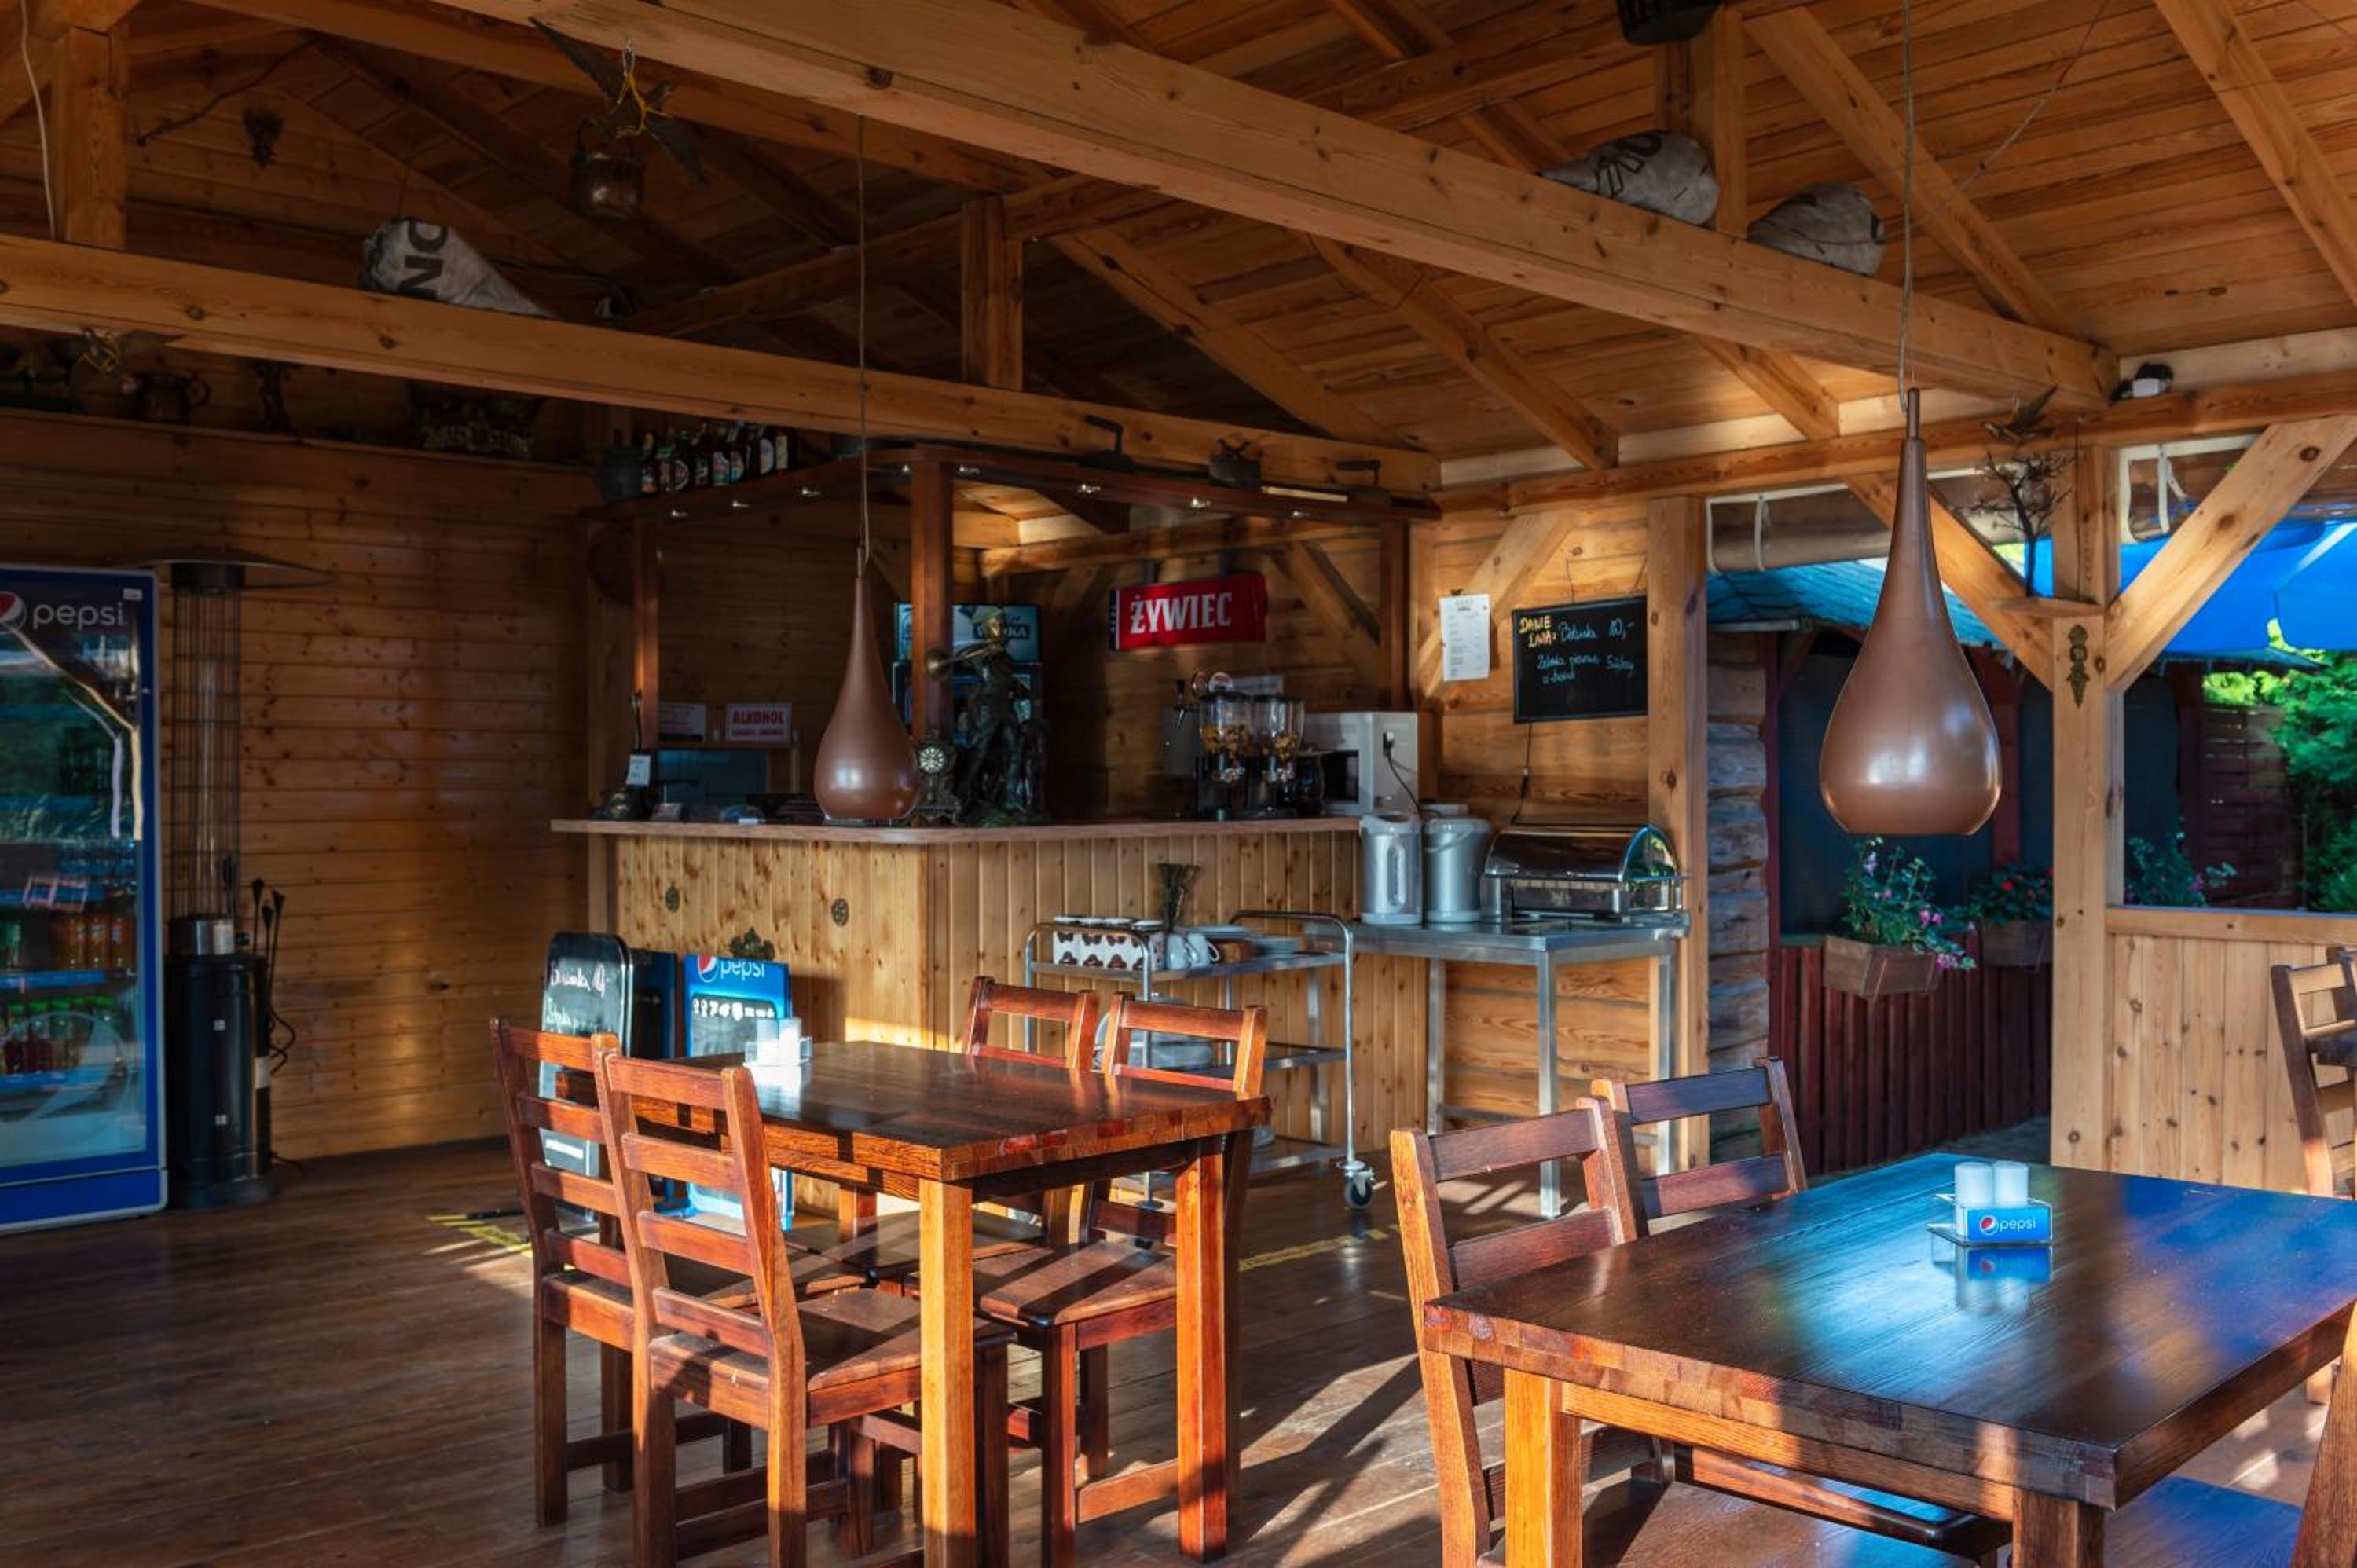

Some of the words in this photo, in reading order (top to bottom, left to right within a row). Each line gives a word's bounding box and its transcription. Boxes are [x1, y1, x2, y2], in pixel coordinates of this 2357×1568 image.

[32, 602, 124, 631] pepsi
[1130, 592, 1233, 634] ŻYWIEC
[732, 710, 785, 725] ALKOHOL
[720, 959, 765, 981] pepsi
[2000, 1218, 2036, 1233] pepsi
